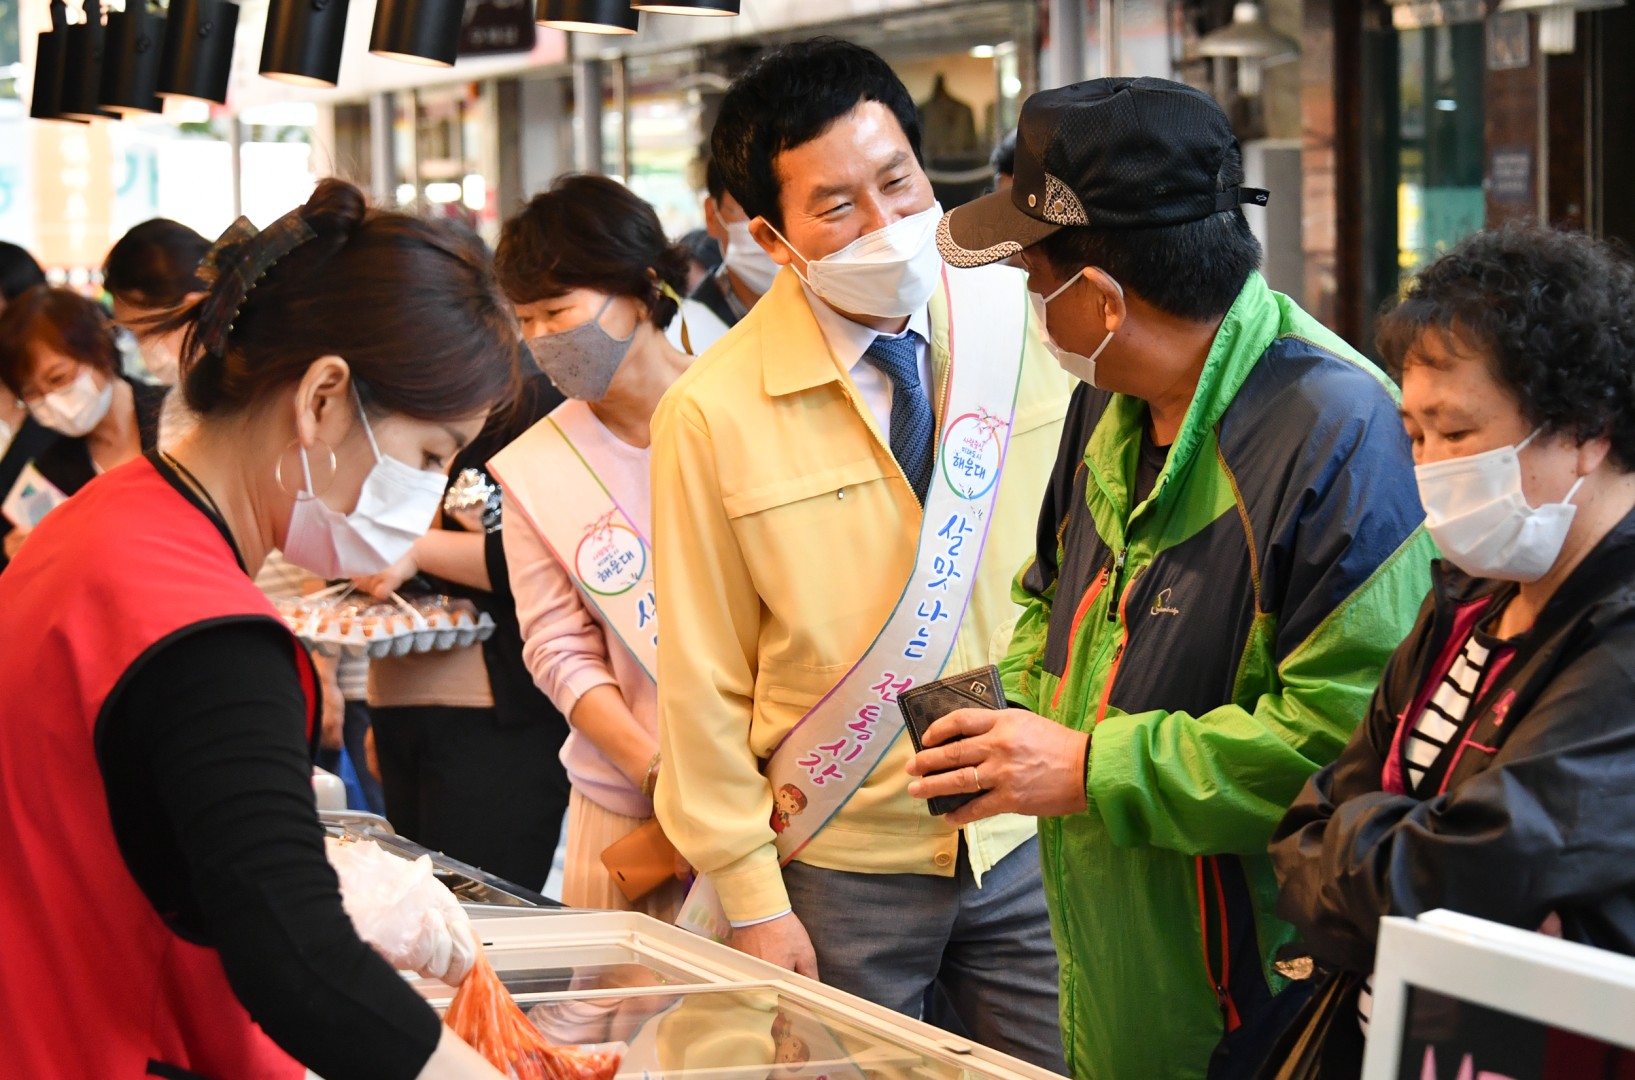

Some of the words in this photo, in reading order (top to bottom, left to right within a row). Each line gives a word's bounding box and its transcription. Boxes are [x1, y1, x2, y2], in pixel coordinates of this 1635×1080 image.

[952, 452, 986, 480] 해운대
[597, 550, 635, 583] 해운대
[798, 672, 914, 785] 전통시장
